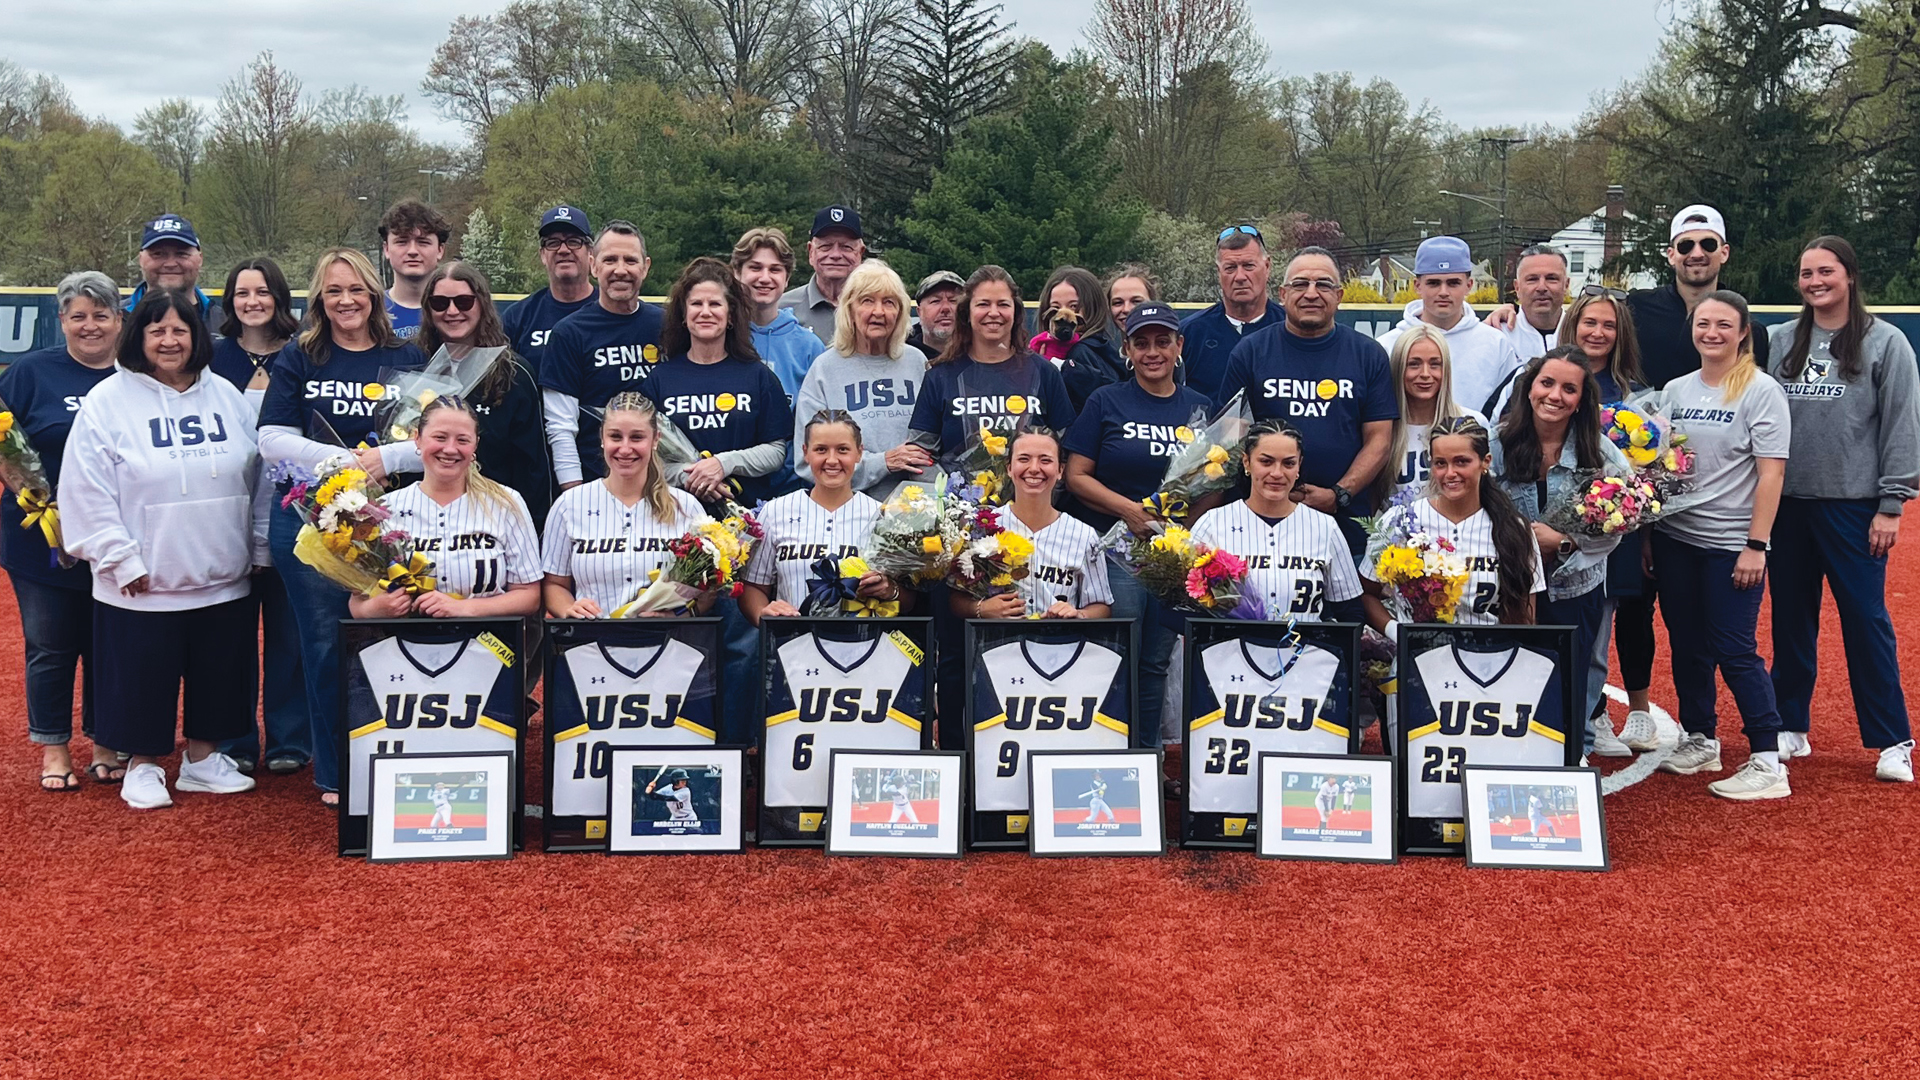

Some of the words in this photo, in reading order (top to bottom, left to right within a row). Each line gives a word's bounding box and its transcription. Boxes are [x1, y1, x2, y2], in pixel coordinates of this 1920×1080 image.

[153, 219, 181, 231] USJ
[304, 380, 401, 400] SENIOR
[664, 392, 751, 416] SENIOR
[844, 379, 916, 411] USJ
[952, 395, 1042, 416] SENIOR
[1263, 378, 1354, 400] SENIOR
[332, 400, 377, 416] DAY
[688, 413, 730, 430] DAY
[979, 415, 1021, 431] DAY
[1289, 401, 1331, 417] DAY
[148, 412, 228, 448] USJ
[1150, 441, 1191, 457] DAY
[448, 533, 497, 551] JAYS
[575, 538, 627, 554] BLUE
[633, 538, 683, 552] JAY
[777, 544, 829, 561] BLUE
[472, 559, 498, 594] 11
[1034, 564, 1074, 587] JAYS
[1277, 555, 1325, 571] JAYS
[1290, 578, 1325, 614] 32
[480, 631, 516, 665] CAPTAIN
[889, 629, 926, 664] CAPTAIN
[384, 693, 482, 730] USJ
[585, 693, 683, 731] USJ
[798, 687, 893, 724] USJ
[1003, 696, 1099, 731] USJ
[1223, 693, 1319, 732] USJ
[1438, 700, 1533, 738] USJ
[572, 740, 609, 780] 10
[792, 732, 815, 771] 6
[996, 740, 1020, 778] 9
[1204, 737, 1251, 776] 32
[1421, 745, 1467, 783] 23
